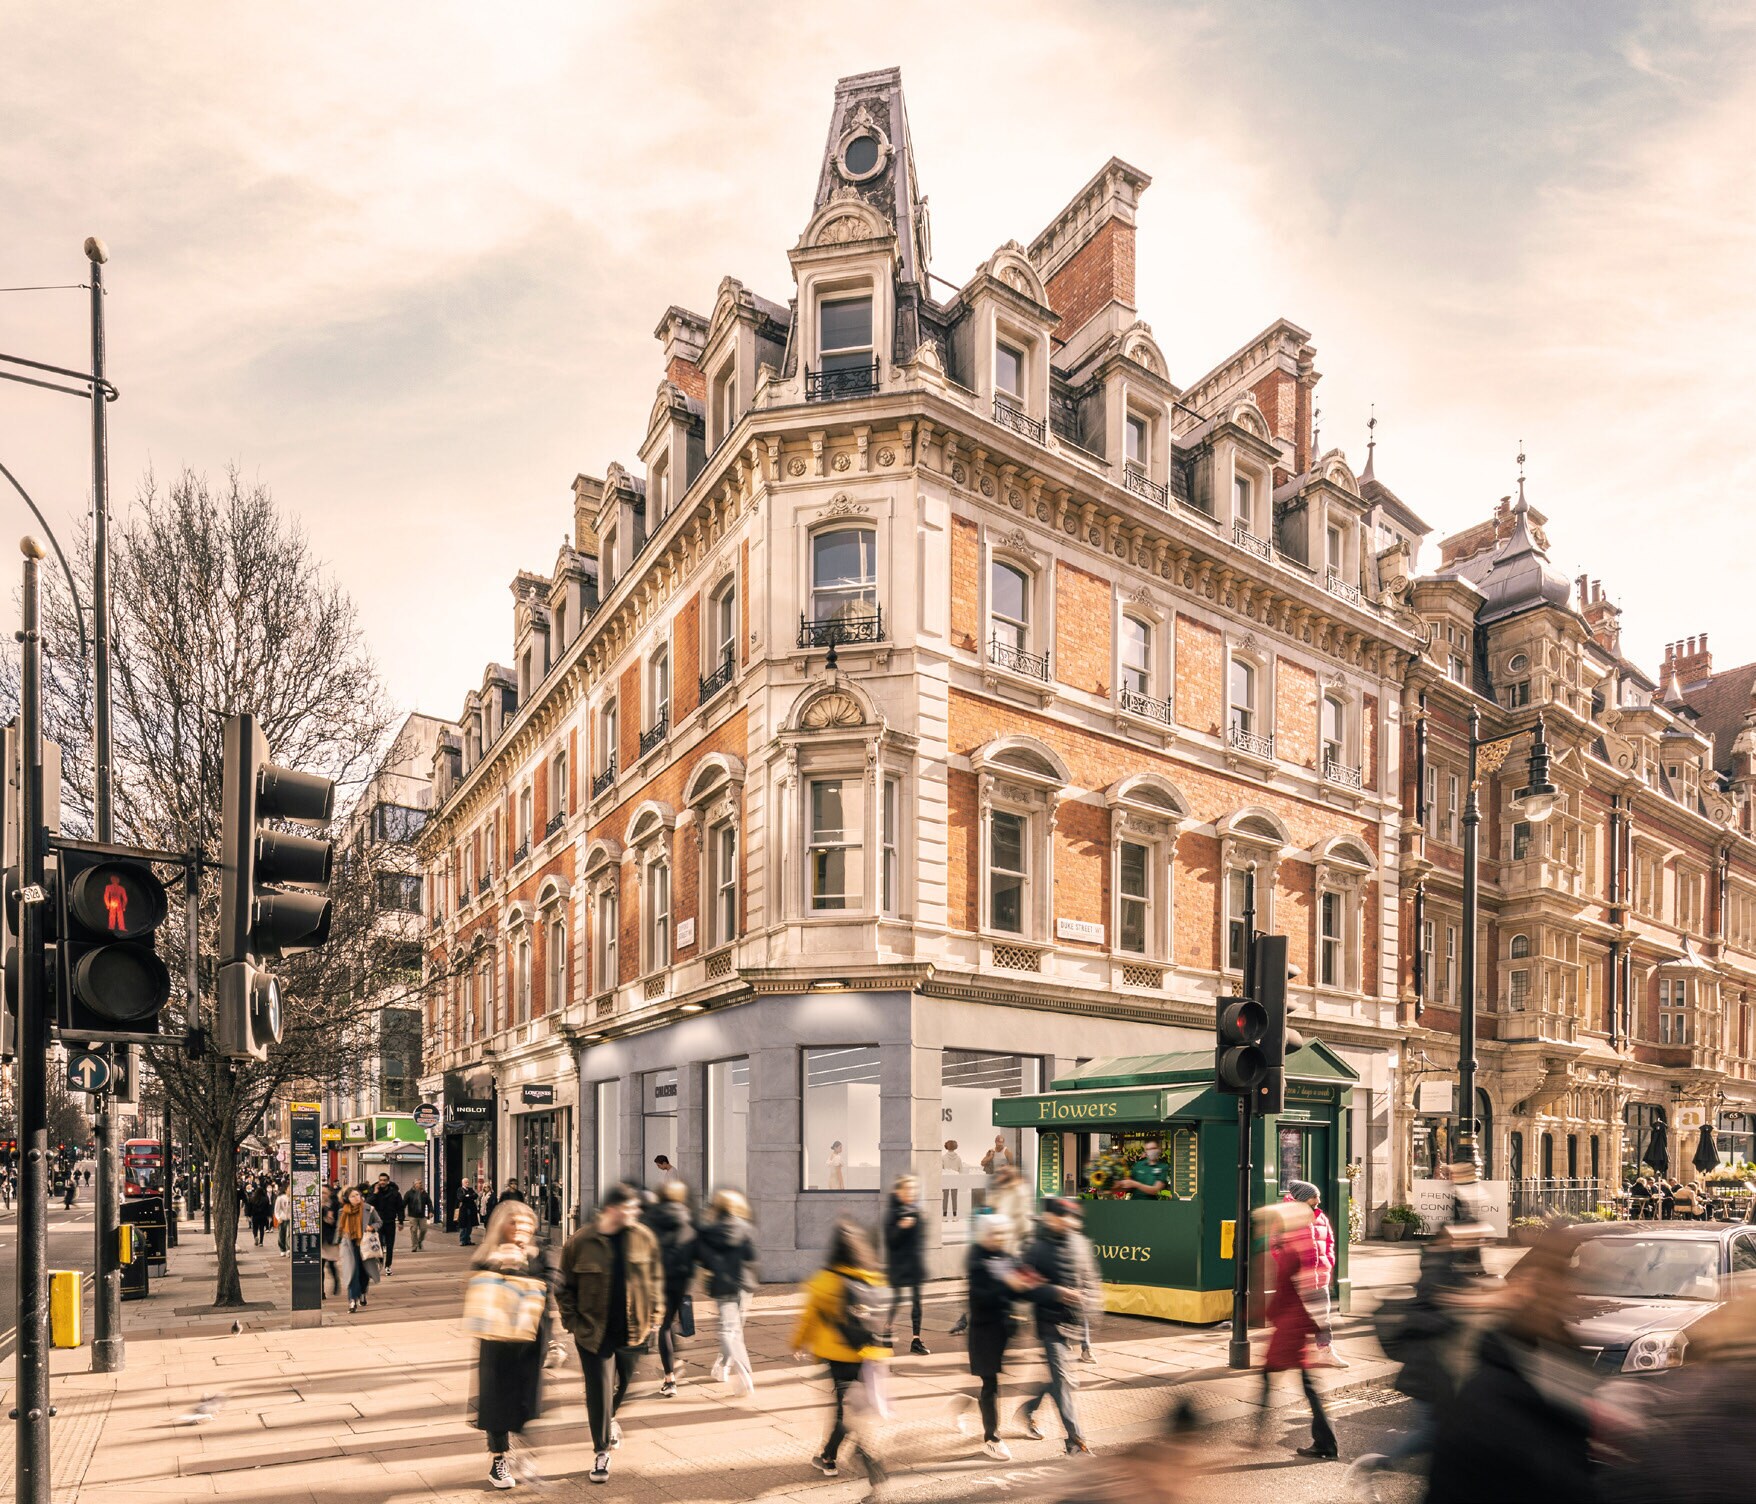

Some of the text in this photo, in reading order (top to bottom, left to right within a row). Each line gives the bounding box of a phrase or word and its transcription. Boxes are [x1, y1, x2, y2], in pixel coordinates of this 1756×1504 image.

[1060, 921, 1074, 931] DUKE
[1075, 923, 1093, 933] STREET
[1038, 1100, 1118, 1119] Flowers
[1682, 1111, 1699, 1125] a
[1420, 1192, 1457, 1200] FRENC
[1090, 1244, 1151, 1262] owers
